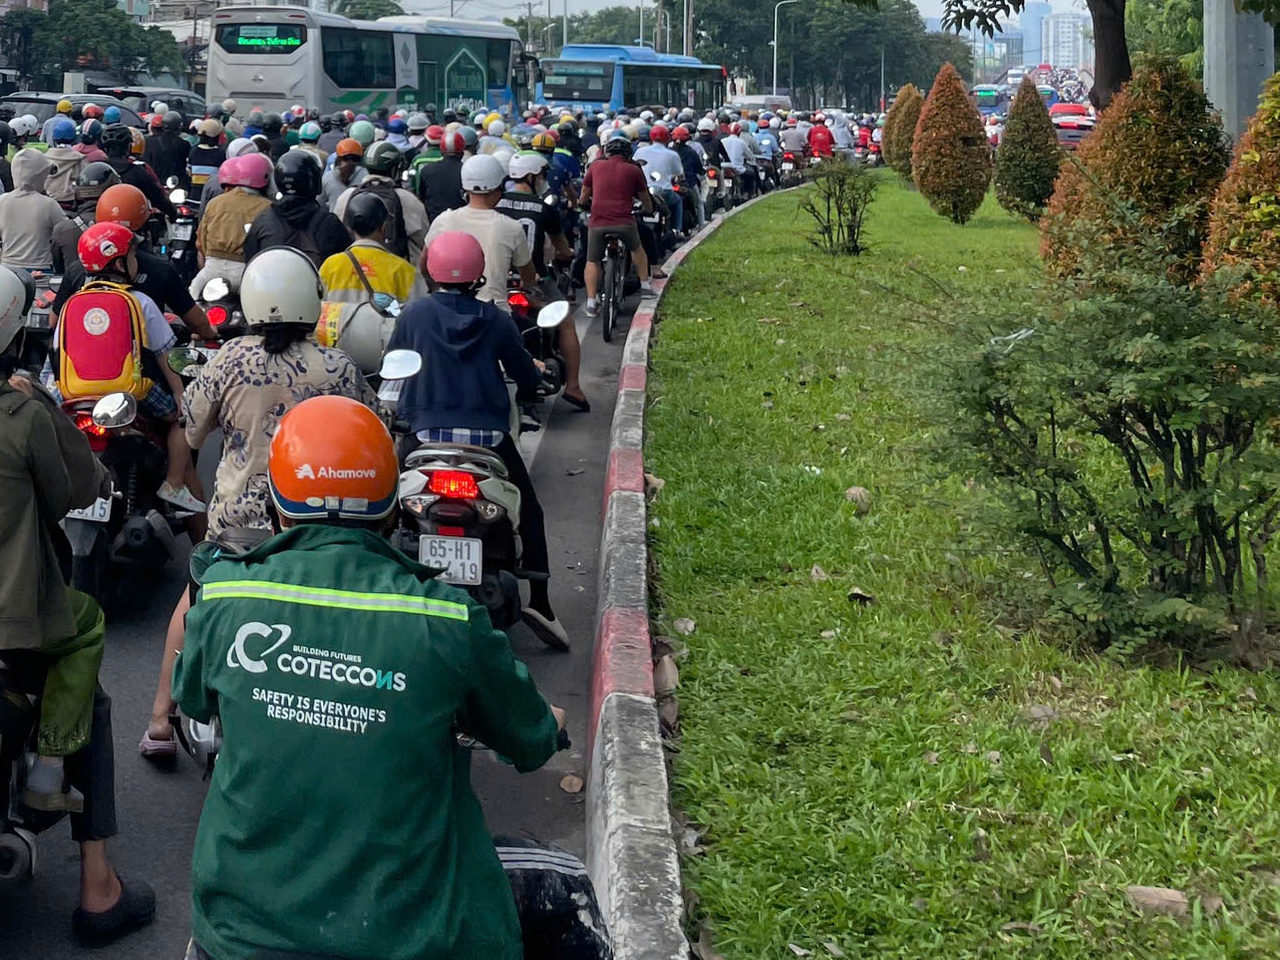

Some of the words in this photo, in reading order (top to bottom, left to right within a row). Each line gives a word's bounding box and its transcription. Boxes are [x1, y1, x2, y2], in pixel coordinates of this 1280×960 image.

[317, 465, 377, 479] Ahamove
[429, 539, 471, 561] 65-H1
[292, 644, 329, 658] BUILDING
[330, 650, 362, 663] FUTURES
[252, 687, 295, 707] SAFETY
[297, 696, 310, 710] IS
[313, 699, 387, 723] EVERYONE'S
[267, 705, 368, 734] RESPONSIBILITY
